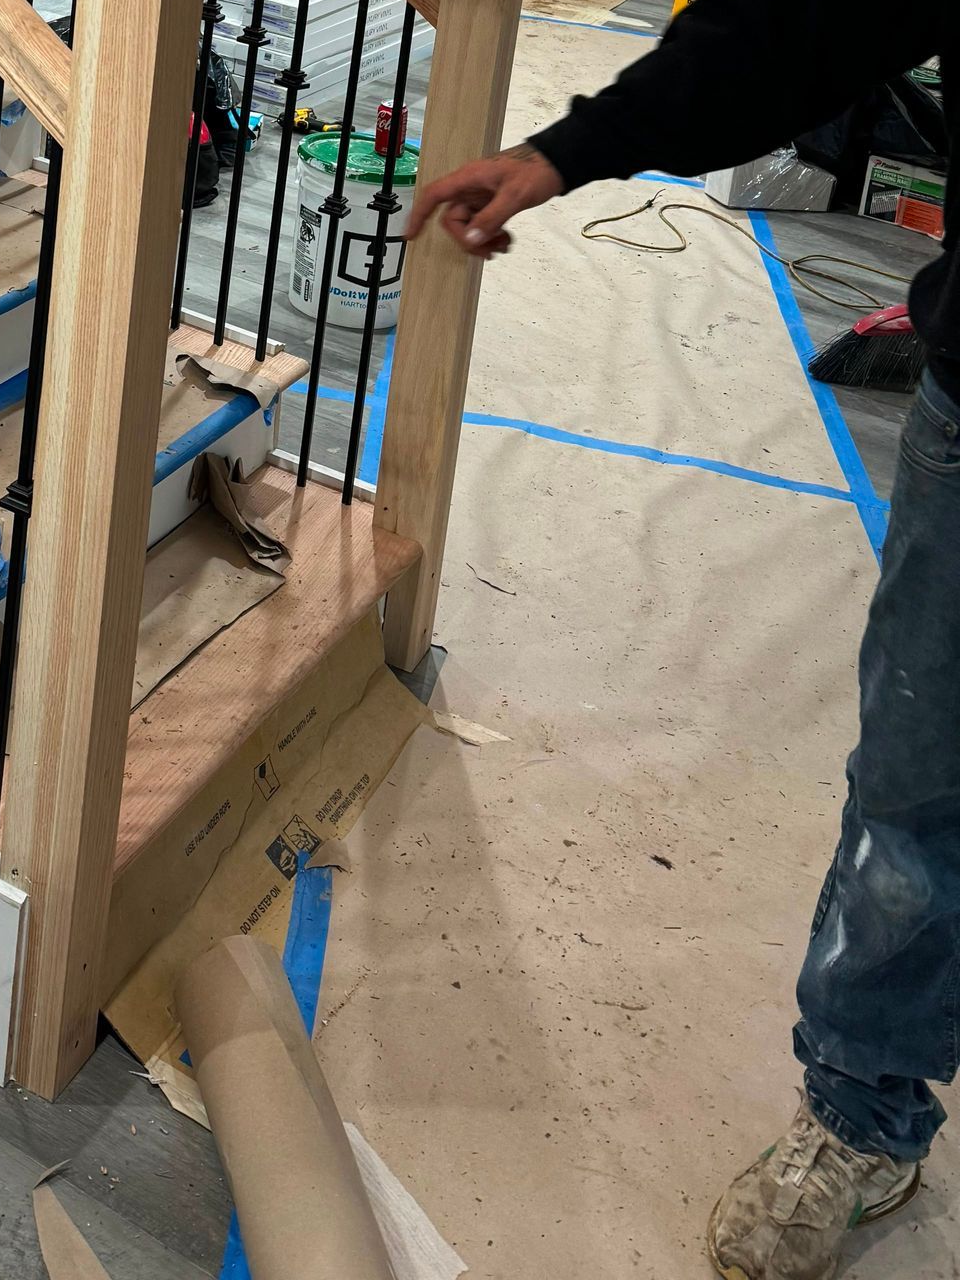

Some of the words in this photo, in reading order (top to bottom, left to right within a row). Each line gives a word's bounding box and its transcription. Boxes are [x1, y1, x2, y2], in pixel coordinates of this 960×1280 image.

[277, 728, 296, 753] HANDLE
[329, 797, 353, 825] SOMETHING
[239, 921, 251, 935] DO
[247, 908, 261, 927] NOT
[257, 894, 273, 913] STEP
[269, 884, 281, 898] ON
